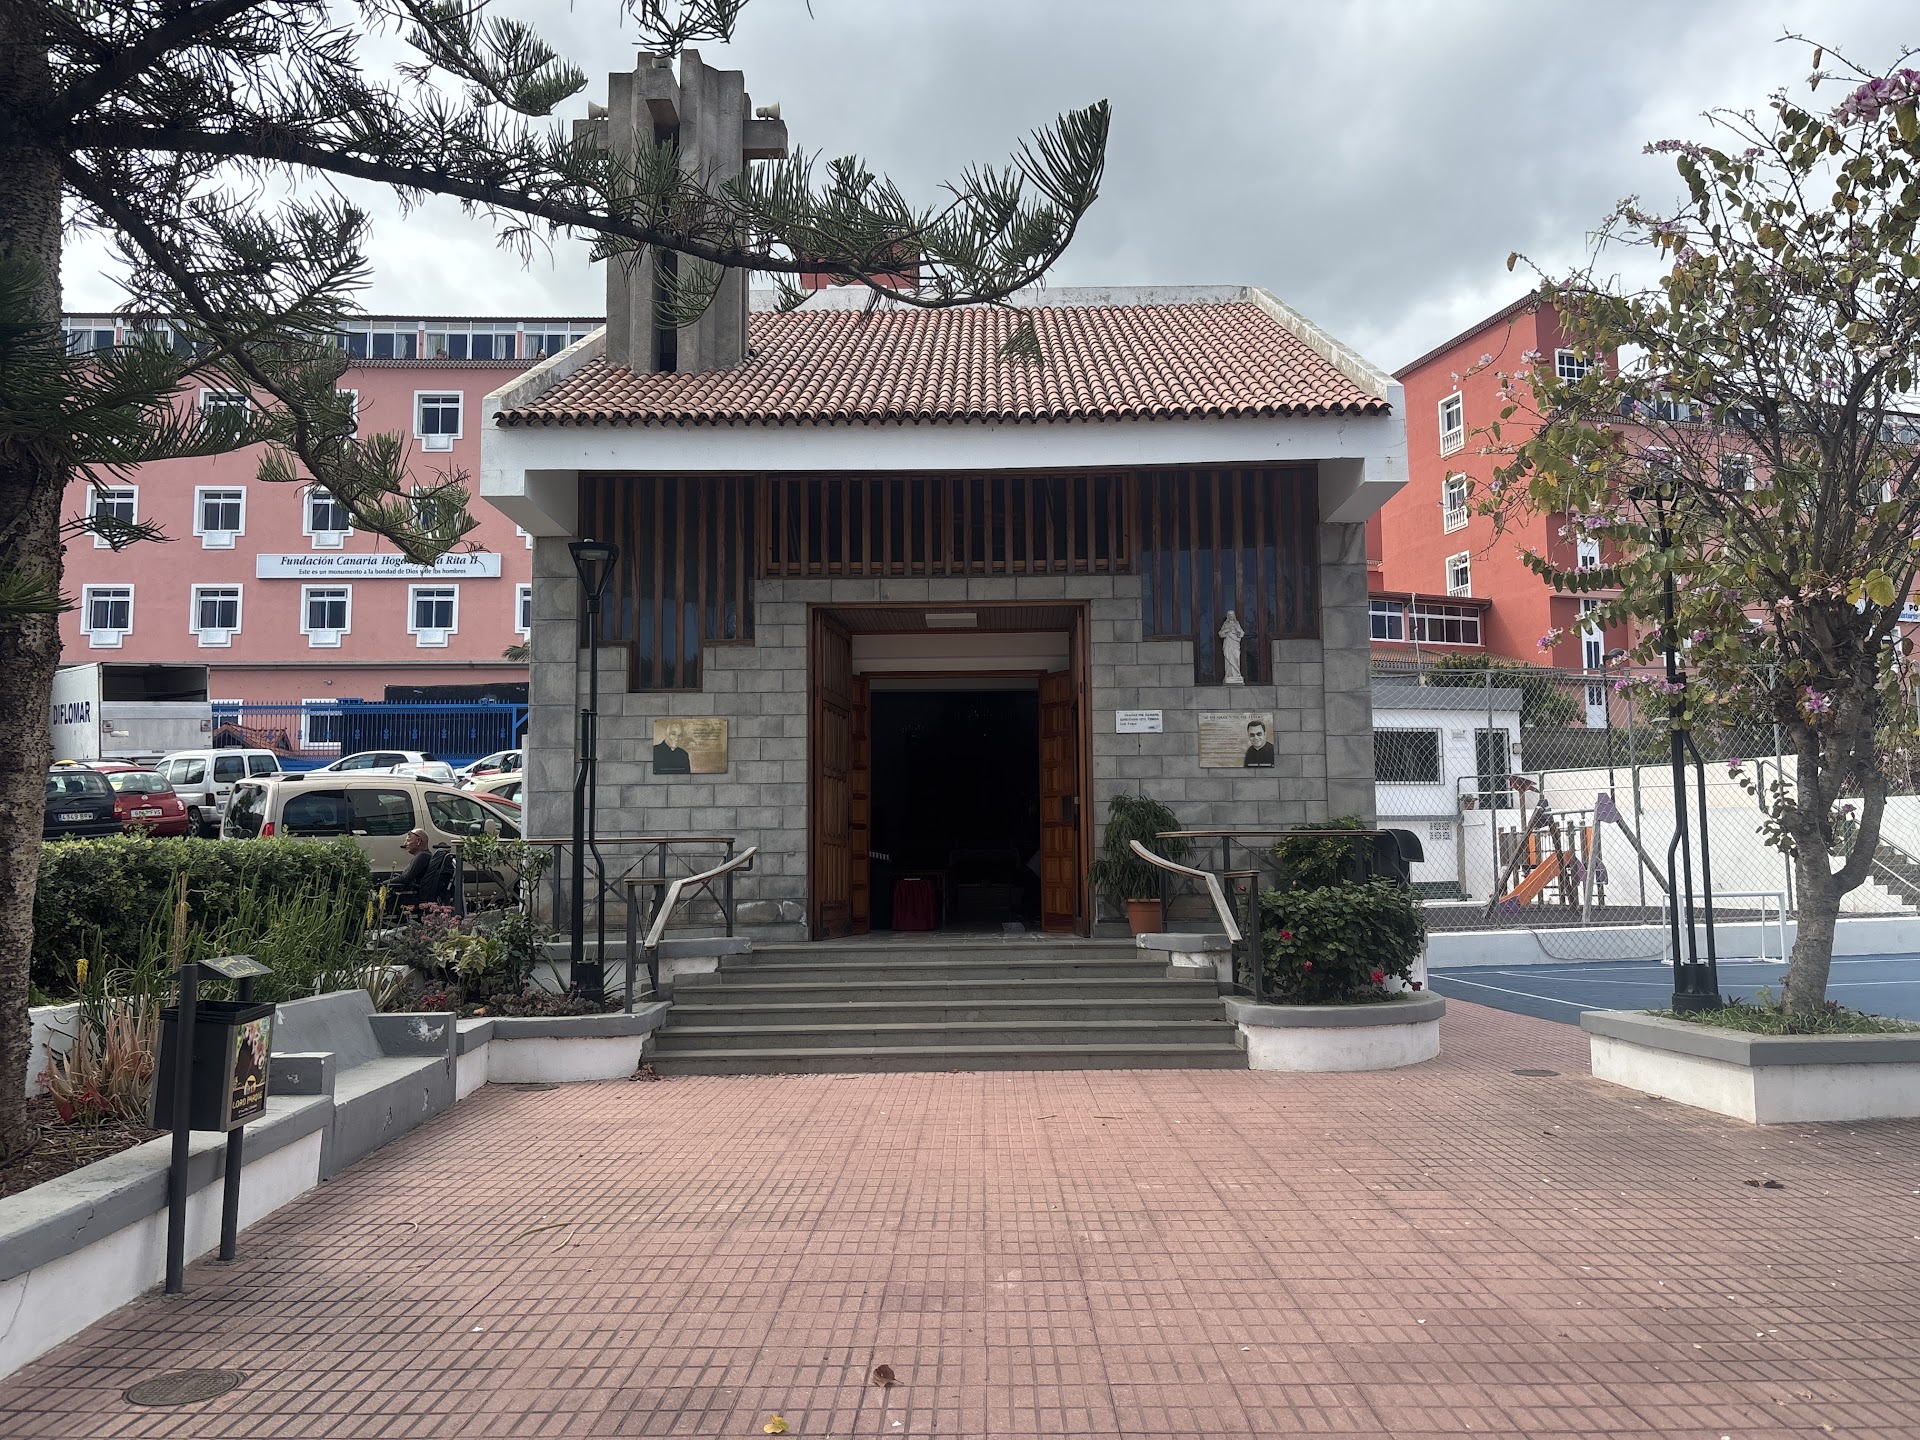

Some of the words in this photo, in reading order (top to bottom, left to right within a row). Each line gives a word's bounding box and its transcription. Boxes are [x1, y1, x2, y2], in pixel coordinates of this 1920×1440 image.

[281, 555, 333, 565] Fundación
[336, 556, 377, 565] Canaria
[381, 556, 411, 567] Hoga
[446, 556, 467, 565] Rita
[53, 701, 91, 725] DIFLOMAR
[232, 1098, 247, 1109] LORO
